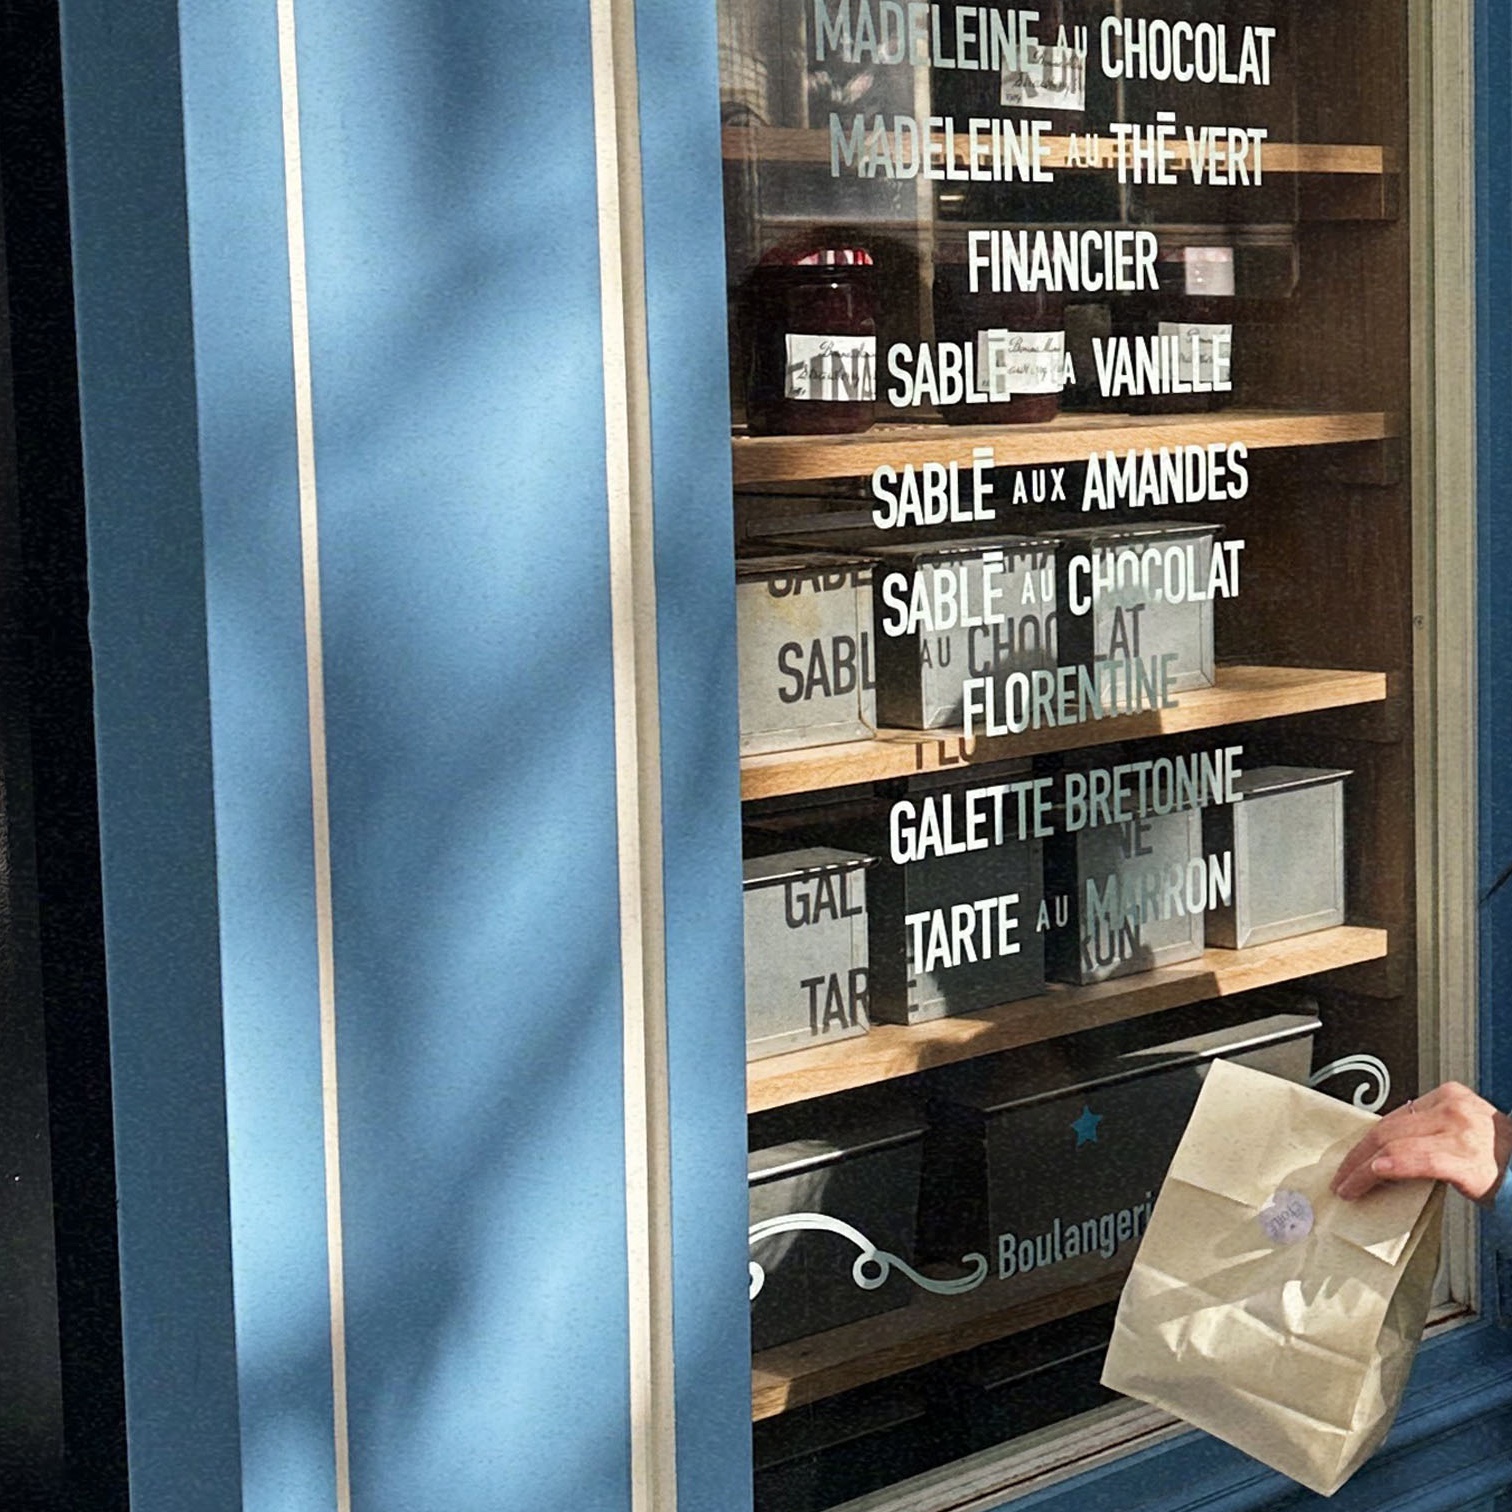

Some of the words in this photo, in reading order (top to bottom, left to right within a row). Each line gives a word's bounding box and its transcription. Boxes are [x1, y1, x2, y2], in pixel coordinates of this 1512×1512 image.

[814, 0, 1041, 73] MADELEINE
[1056, 24, 1088, 59] AU
[1100, 15, 1276, 86] CHOCOLAT
[829, 112, 1054, 183] MADELEINE
[1066, 132, 1098, 168] AU
[1185, 126, 1268, 186] VERT
[968, 230, 1160, 293] FINANCIER
[1092, 333, 1232, 398] VANILLE
[1012, 466, 1067, 505] AUX
[1081, 441, 1249, 512] AMANDES
[1021, 568, 1054, 605] AU
[1068, 540, 1245, 617] CHOCOLAT
[962, 652, 1179, 739] FLORENTINE
[889, 776, 1055, 865] GALETTE
[1064, 745, 1244, 833] BRETONNE
[904, 893, 1021, 976] TARTE
[1035, 894, 1068, 933] AU
[1086, 850, 1232, 940] MARRON
